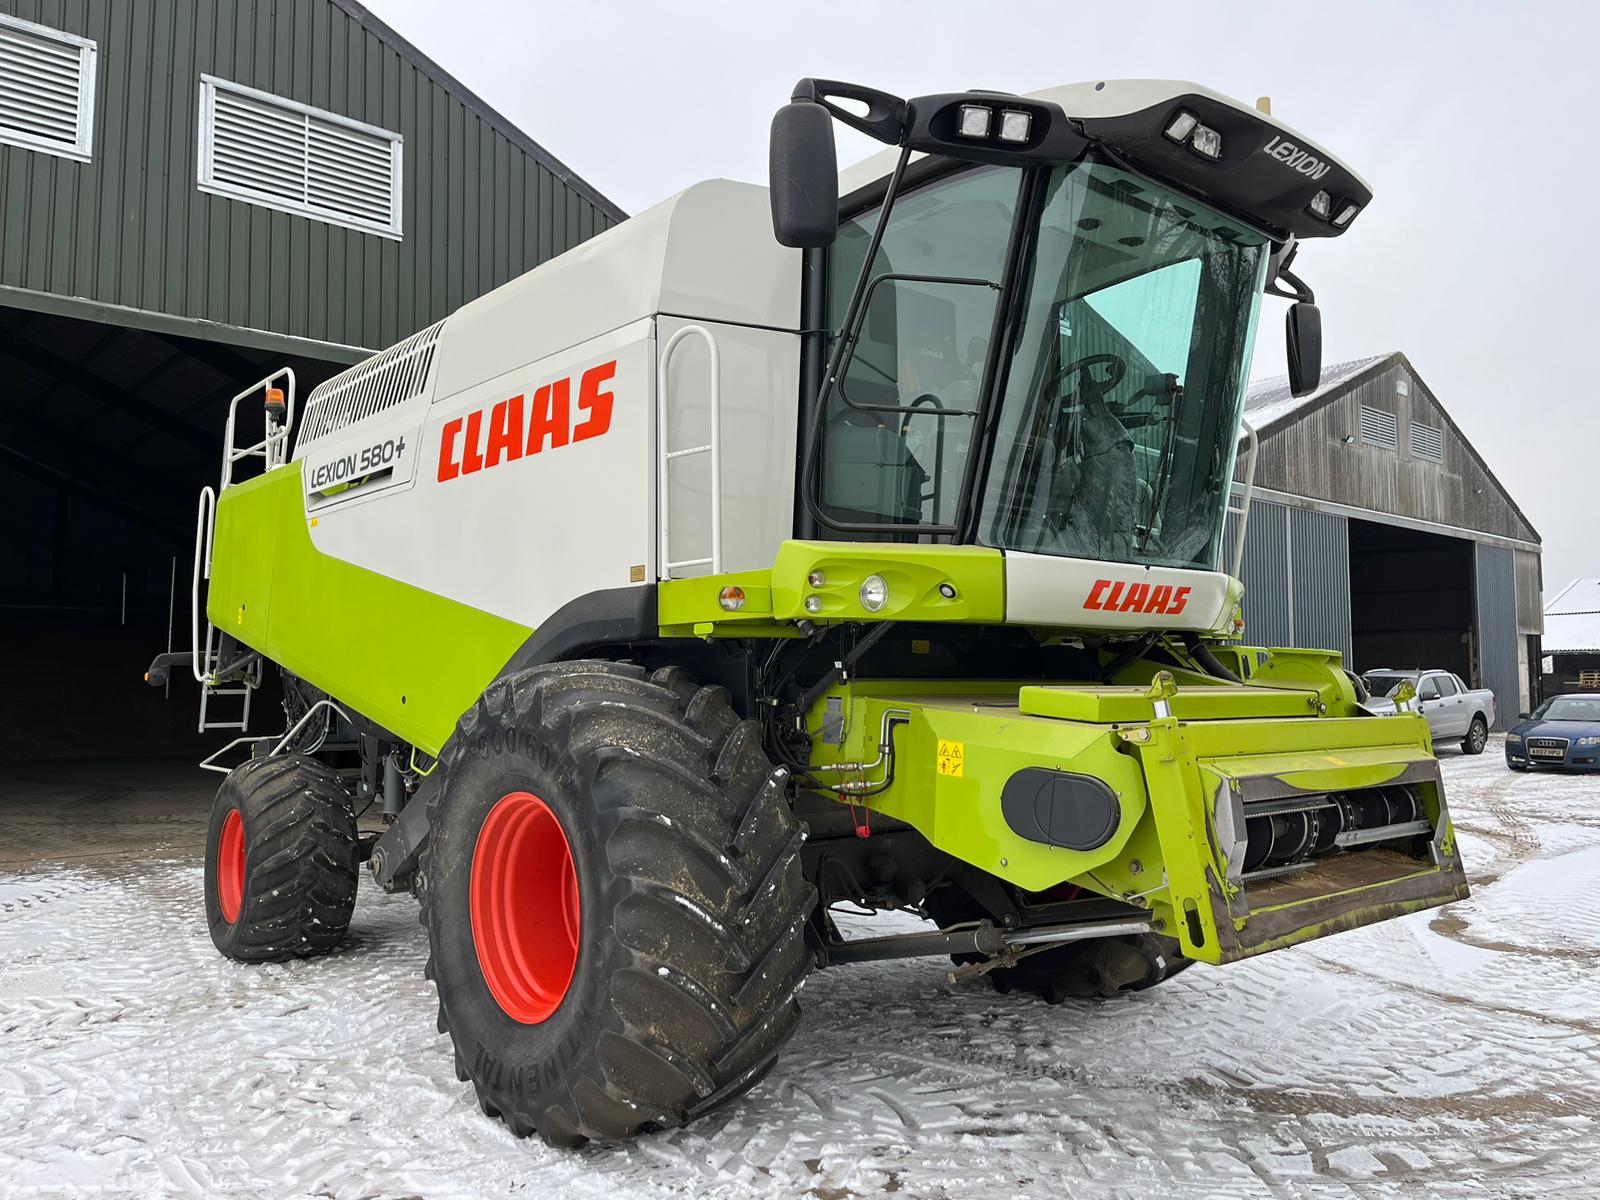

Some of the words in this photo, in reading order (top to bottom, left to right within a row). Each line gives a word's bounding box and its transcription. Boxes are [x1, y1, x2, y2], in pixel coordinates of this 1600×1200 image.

[1263, 135, 1331, 180] LEXION
[437, 360, 617, 483] CLAAS
[311, 453, 357, 488] LEXION
[360, 436, 405, 472] 580+
[1083, 579, 1192, 614] CLAAS
